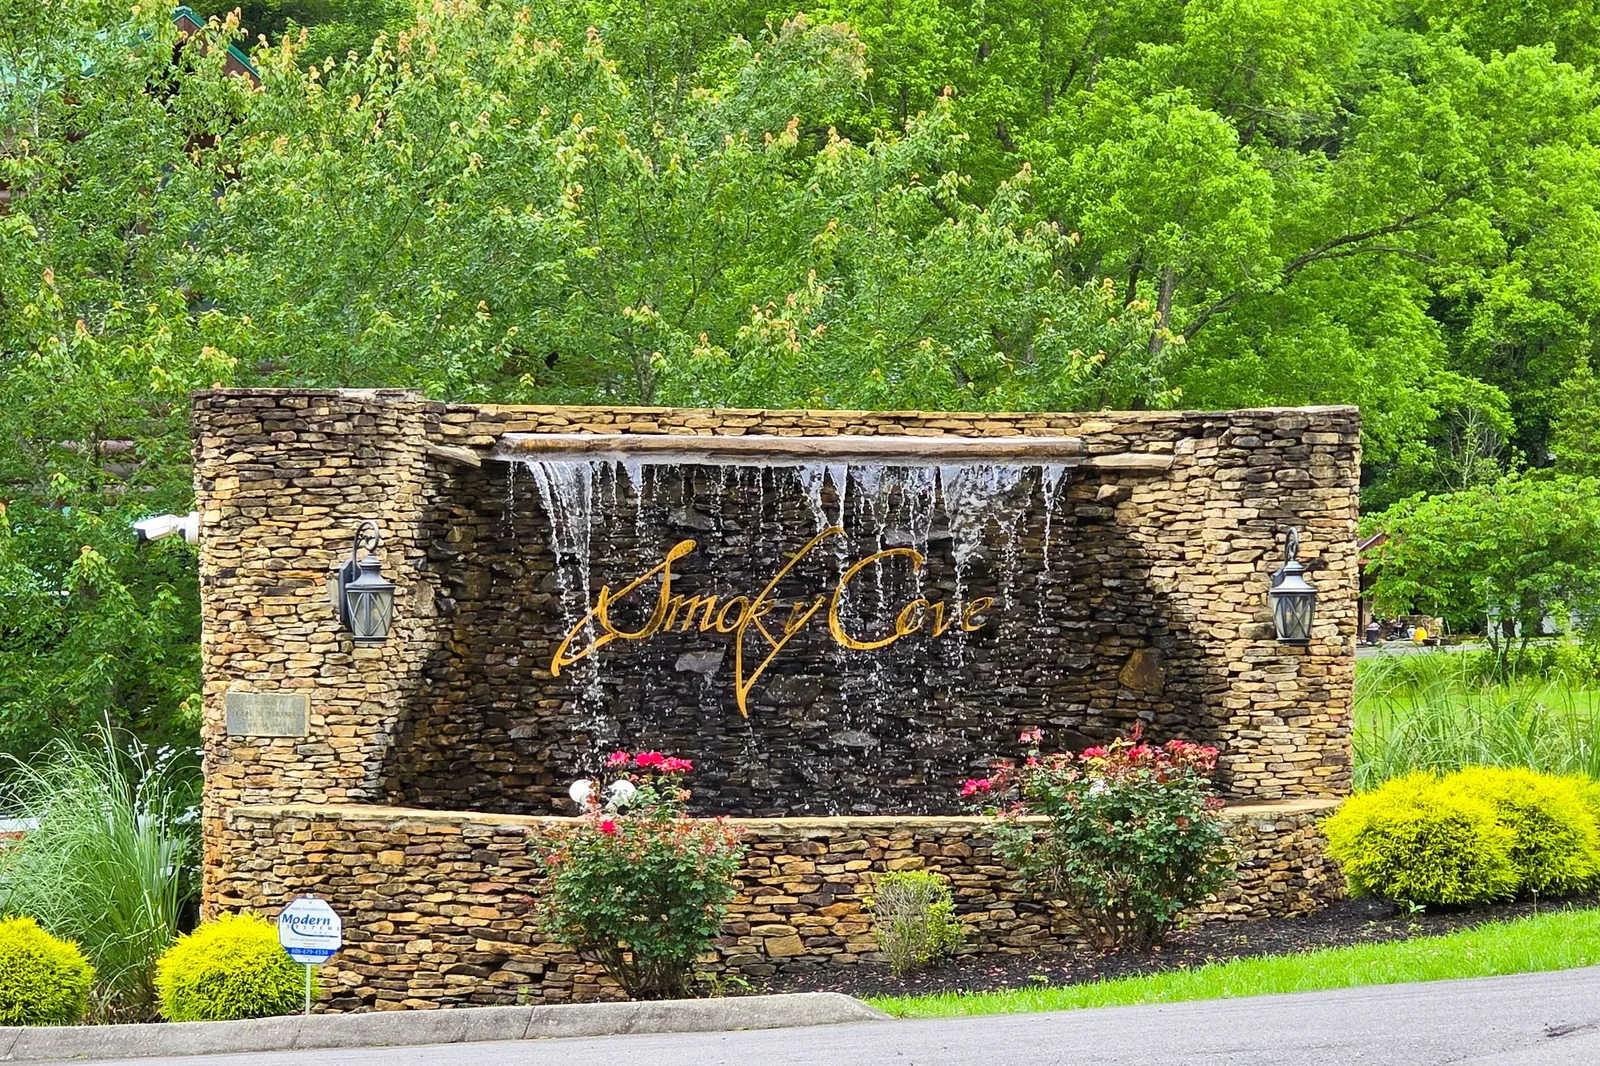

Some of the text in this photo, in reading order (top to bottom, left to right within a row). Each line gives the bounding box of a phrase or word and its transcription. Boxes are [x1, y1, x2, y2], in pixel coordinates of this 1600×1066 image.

[550, 525, 994, 718] Smoky Cove
[282, 914, 331, 926] Modern
